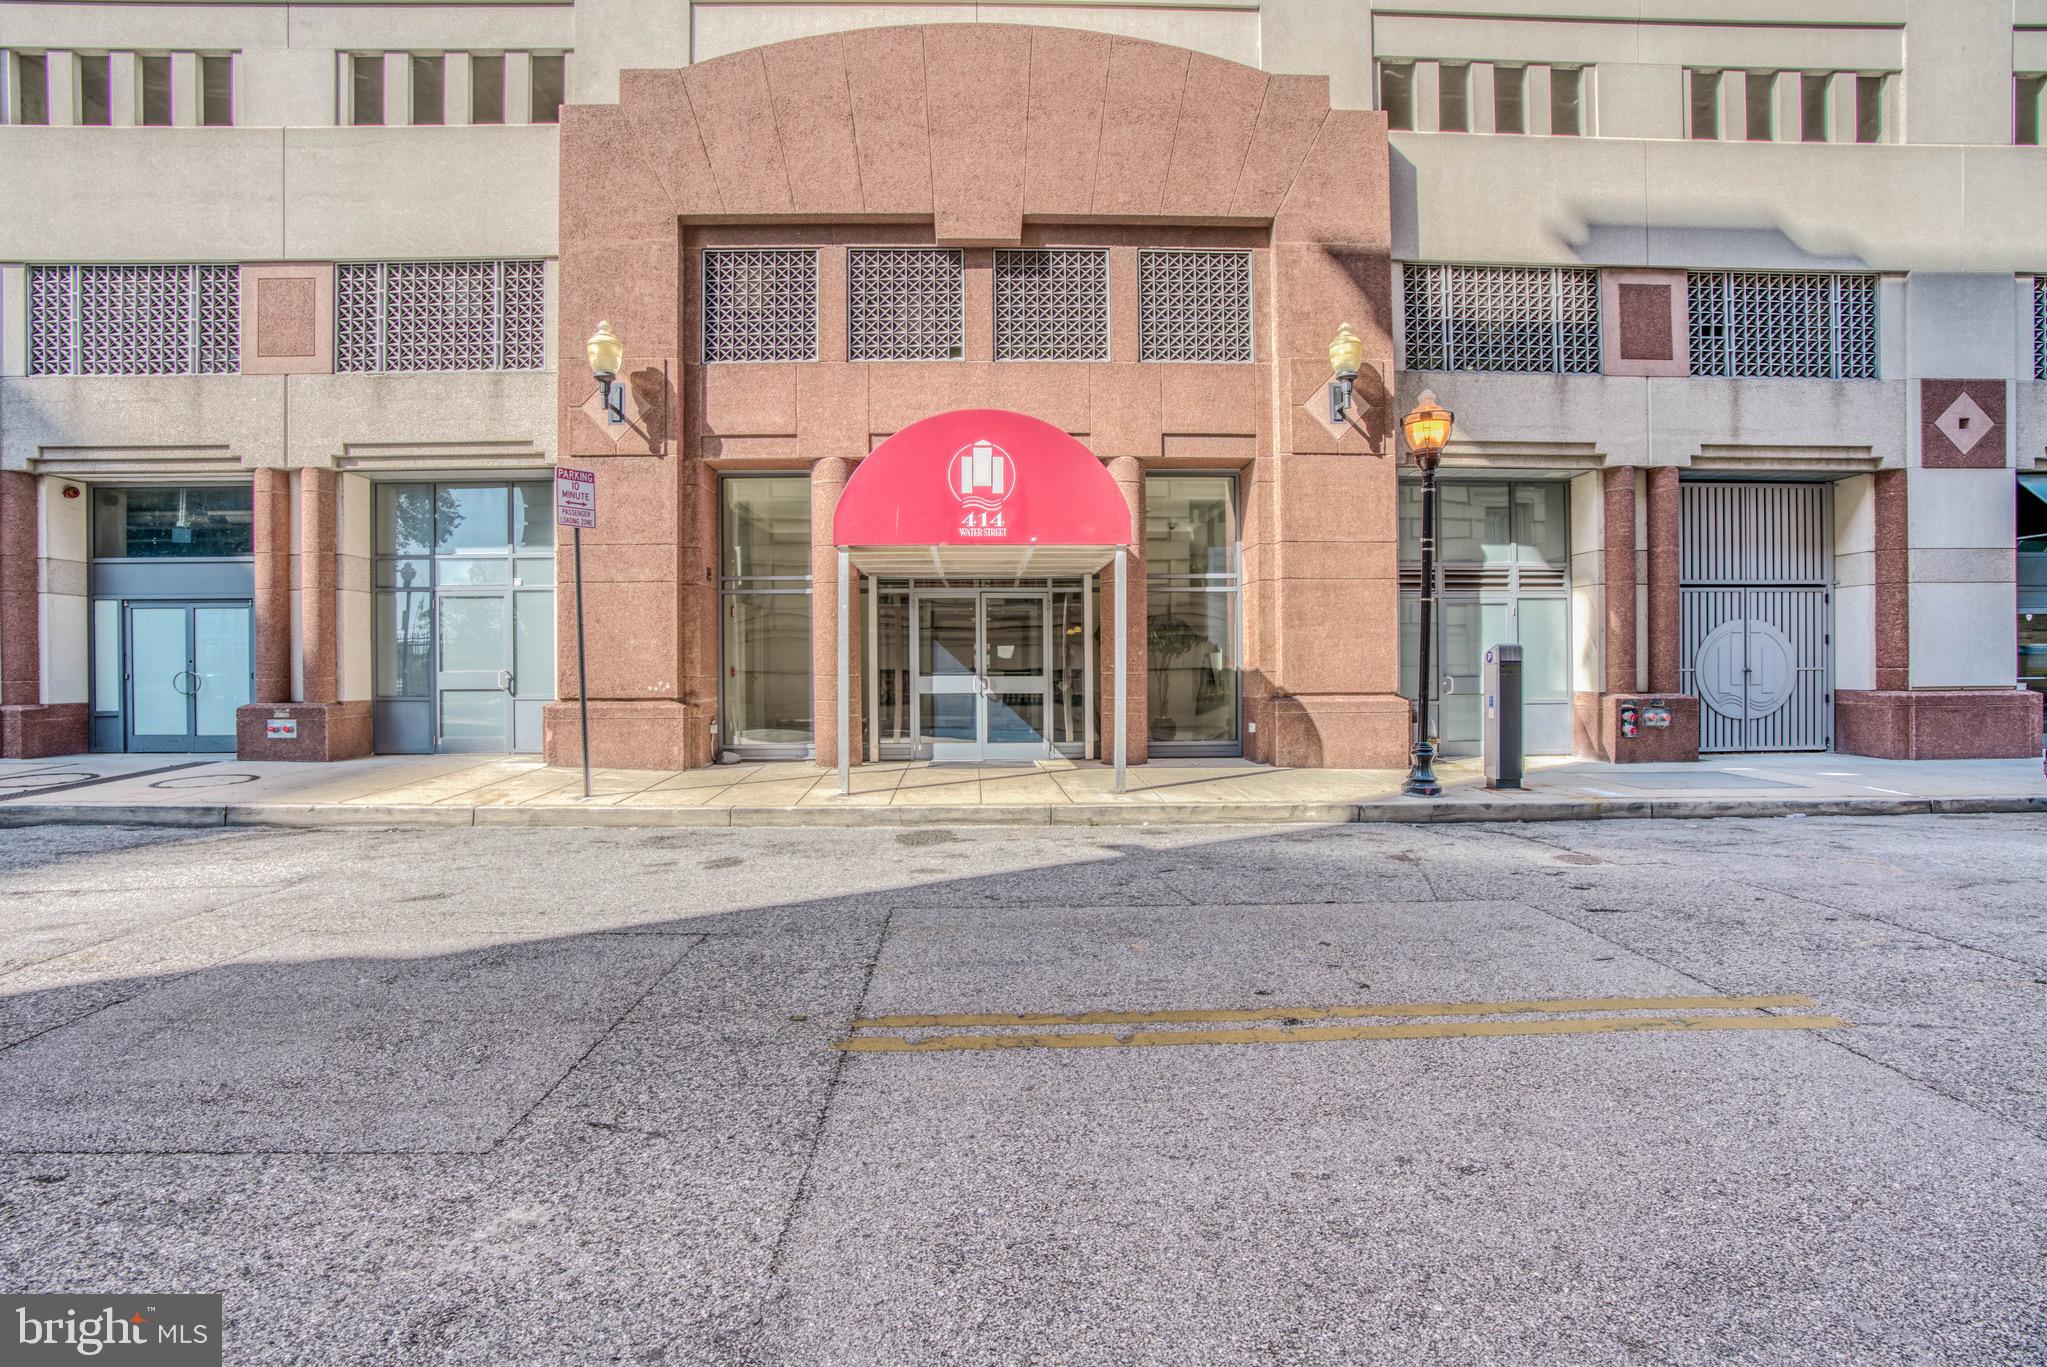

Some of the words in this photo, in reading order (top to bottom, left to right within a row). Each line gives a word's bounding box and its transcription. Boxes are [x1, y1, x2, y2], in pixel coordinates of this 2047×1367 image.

[558, 468, 593, 483] PARKING
[571, 481, 580, 491] 10
[562, 490, 590, 501] MINUTE
[562, 508, 591, 518] PASSENGER
[560, 516, 580, 525] LOADING
[580, 518, 593, 526] ZONE
[960, 511, 1005, 527] 414
[959, 527, 983, 537] WATER
[983, 527, 1007, 537] STREET
